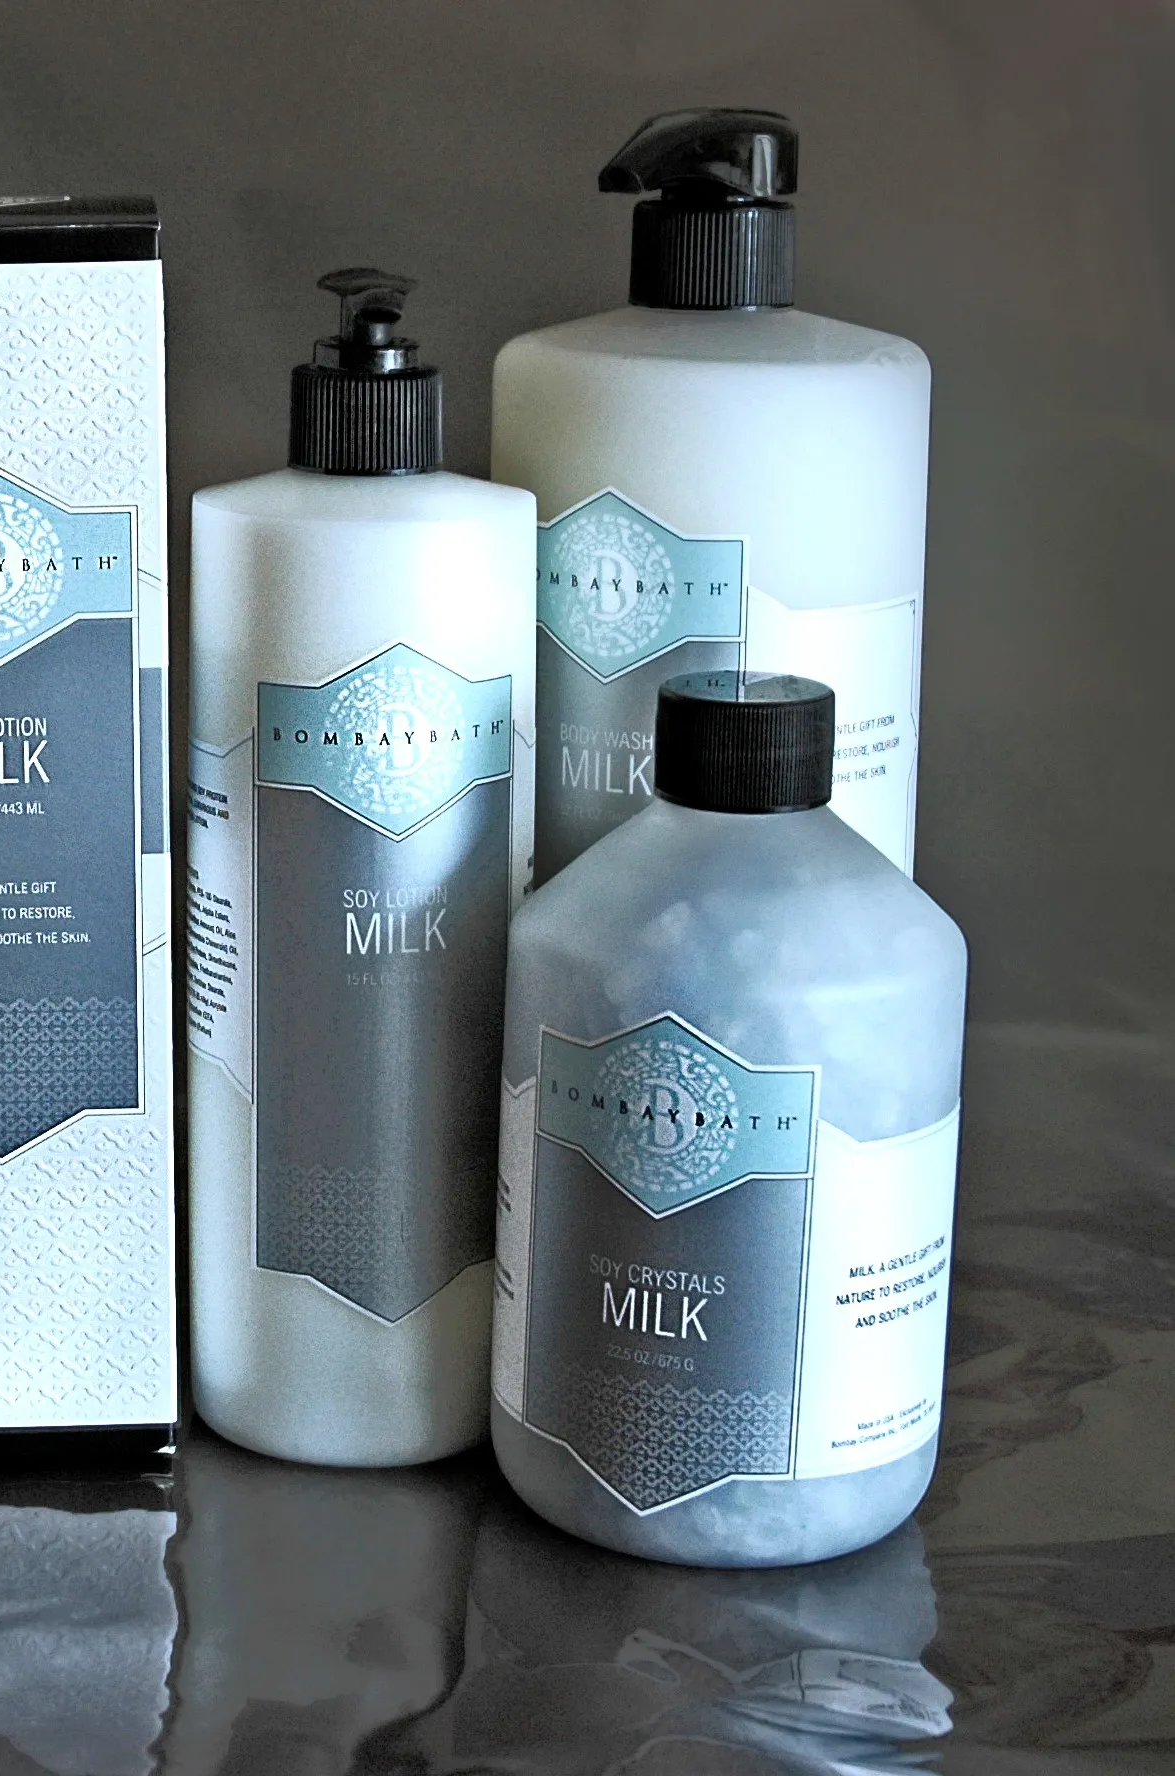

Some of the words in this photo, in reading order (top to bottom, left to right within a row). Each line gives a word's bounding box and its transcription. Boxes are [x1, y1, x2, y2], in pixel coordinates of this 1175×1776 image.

[536, 568, 722, 596] MBAYBATH
[560, 723, 599, 745] BODY
[605, 730, 654, 750] WASH
[561, 745, 653, 796] MILK
[26, 801, 45, 815] ML
[31, 881, 56, 894] GIFT
[343, 889, 380, 908] SOY
[1, 907, 17, 920] TO
[35, 931, 58, 944] THE
[346, 908, 447, 955] MILK
[589, 1254, 623, 1279] SOY
[628, 1264, 725, 1295] CRYSTALS
[879, 1261, 886, 1273] A
[836, 1288, 876, 1305] NATURE
[879, 1285, 890, 1298] TO
[603, 1282, 708, 1342] MILK
[855, 1314, 876, 1328] AND
[684, 1358, 694, 1372] G
